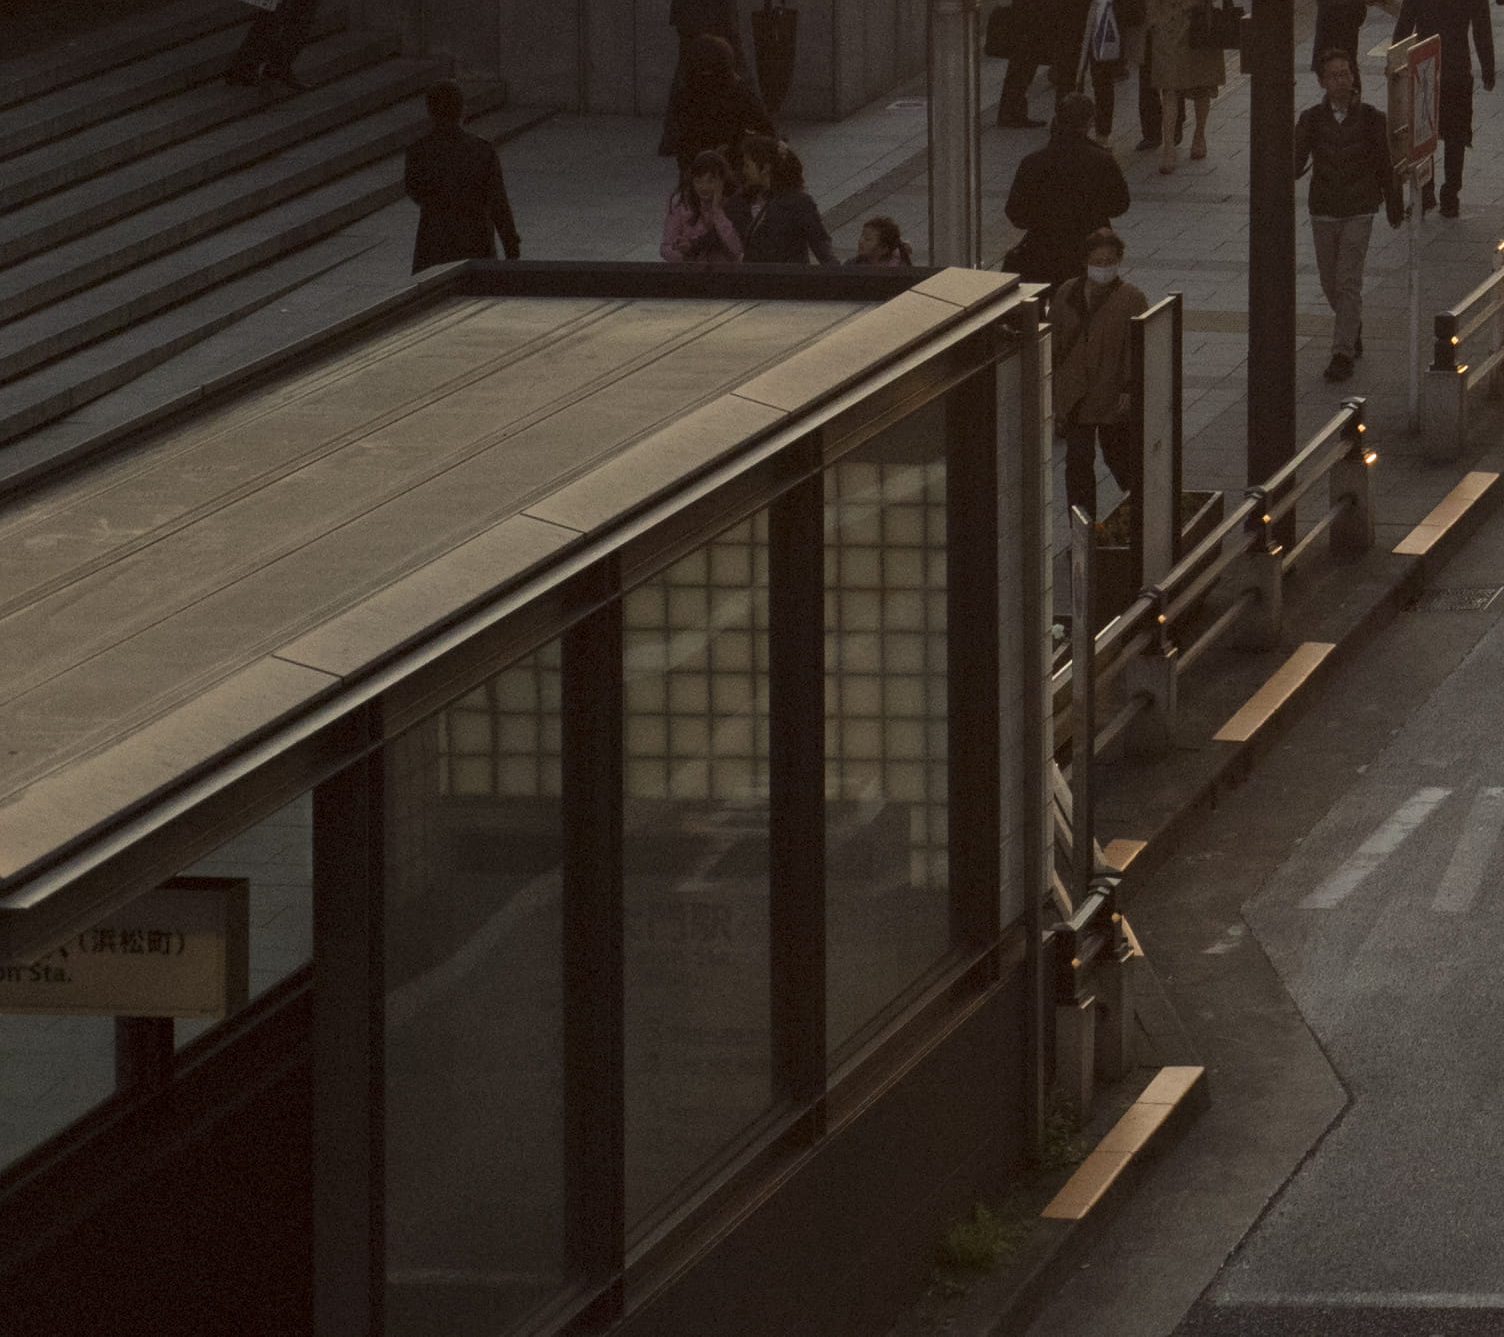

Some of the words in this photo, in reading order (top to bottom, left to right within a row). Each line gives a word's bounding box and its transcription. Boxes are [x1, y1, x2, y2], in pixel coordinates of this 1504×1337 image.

[77, 928, 186, 957] (浜松町)
[28, 961, 73, 984] Sta.
